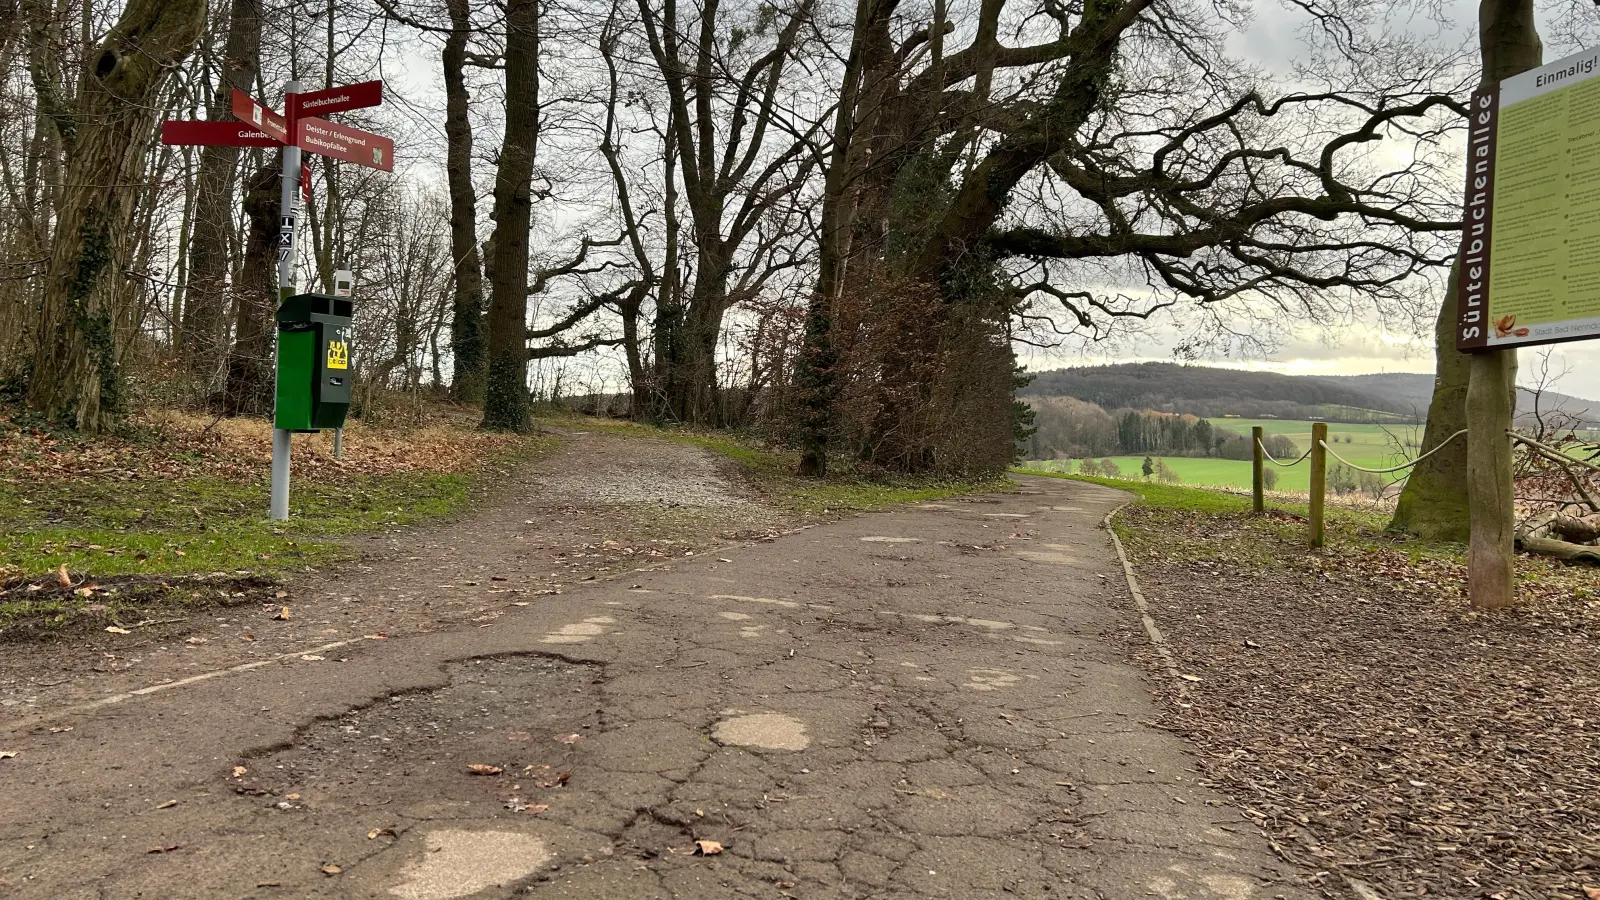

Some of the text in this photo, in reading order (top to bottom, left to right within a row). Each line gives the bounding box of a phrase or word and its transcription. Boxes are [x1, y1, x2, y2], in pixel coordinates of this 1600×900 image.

[1536, 55, 1598, 88] Einmalig!
[302, 94, 350, 109] Süntelbuchenallee
[305, 123, 329, 137] Deister
[333, 131, 366, 146] Erlengrund
[305, 135, 347, 153] Bubikopfallee
[1462, 94, 1492, 341] Süntelbuchenallee
[1534, 326, 1553, 336] Stadt
[1554, 324, 1569, 334] Bad
